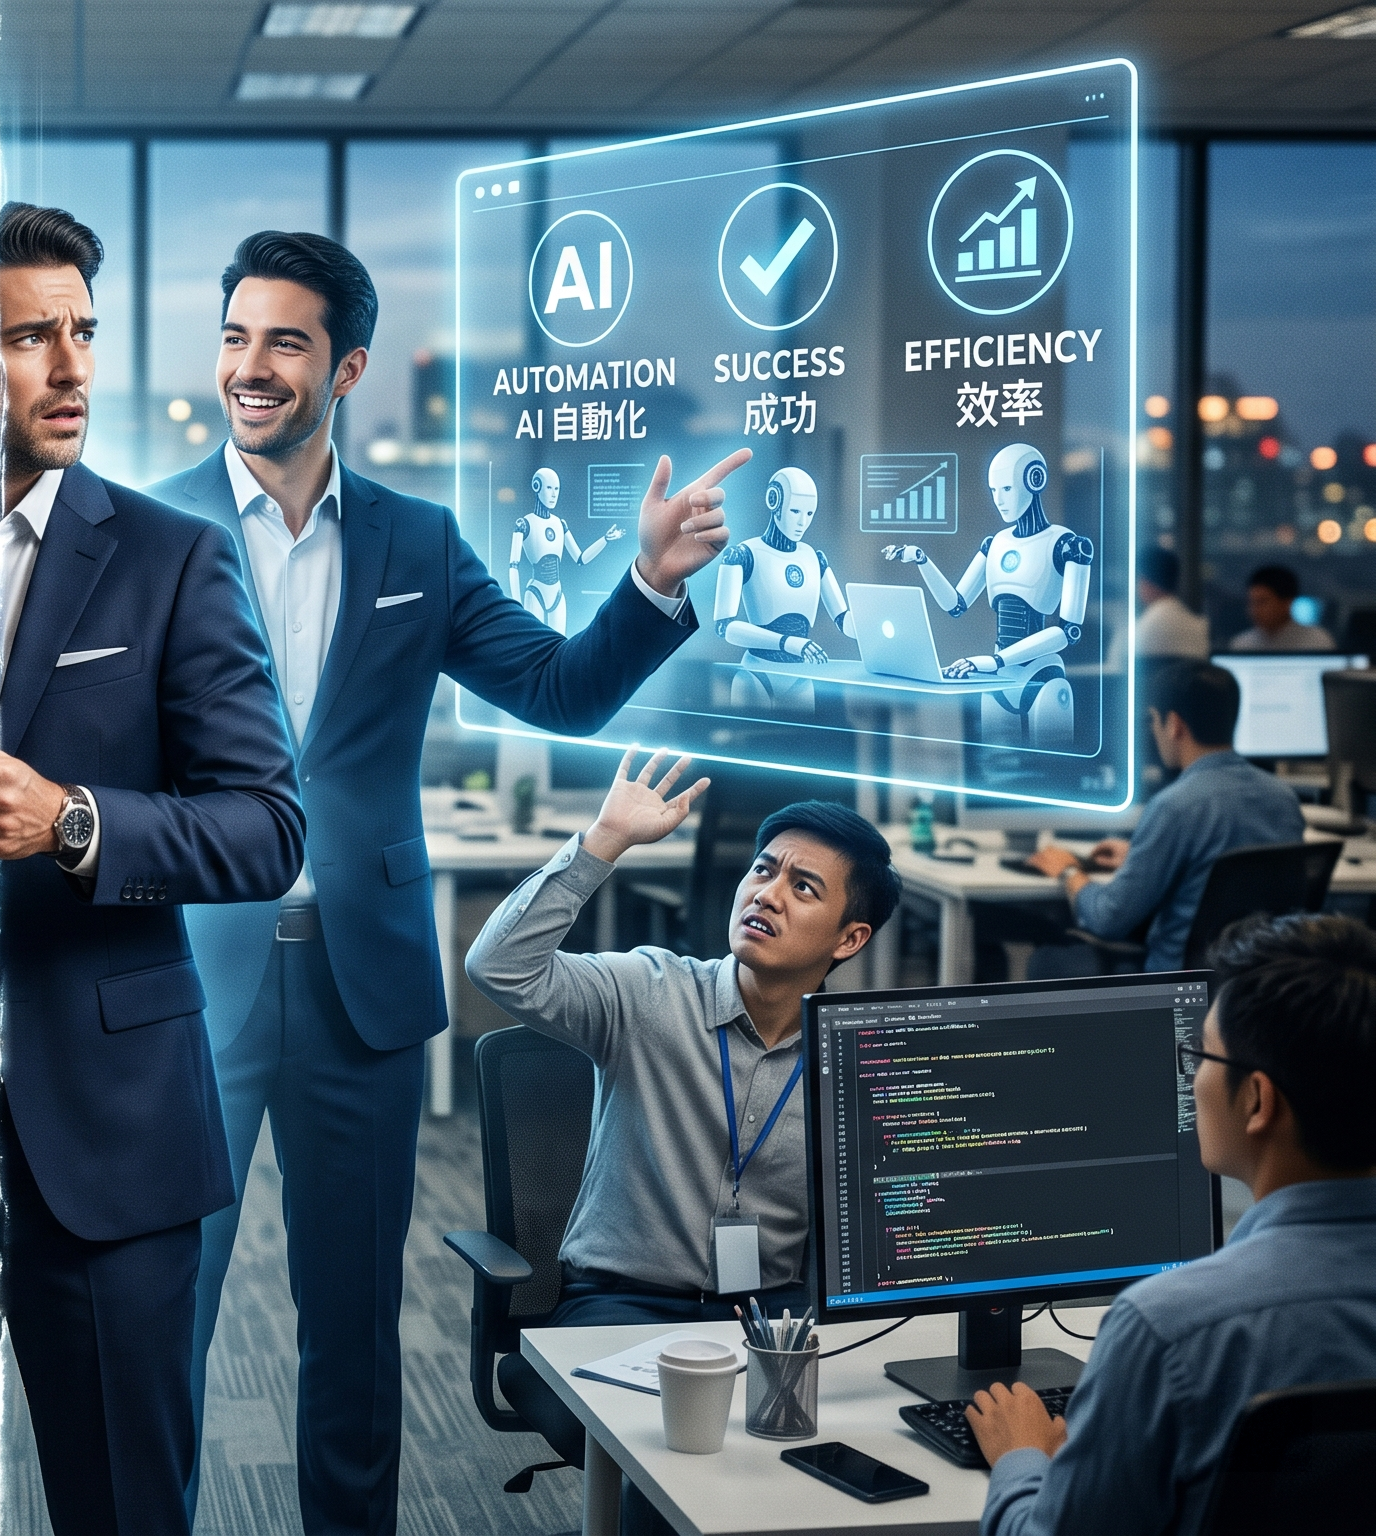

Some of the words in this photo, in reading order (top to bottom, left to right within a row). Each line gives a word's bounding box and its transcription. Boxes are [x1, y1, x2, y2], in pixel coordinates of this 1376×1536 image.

[543, 241, 613, 314] AI
[714, 345, 846, 383] SUCCESS
[905, 328, 1103, 372] EFFICIENCY
[492, 357, 676, 396] AUTOMATION
[515, 409, 543, 439] AI
[553, 399, 647, 442] 自動化
[743, 390, 817, 436] 成功
[956, 378, 1044, 428] 效率
